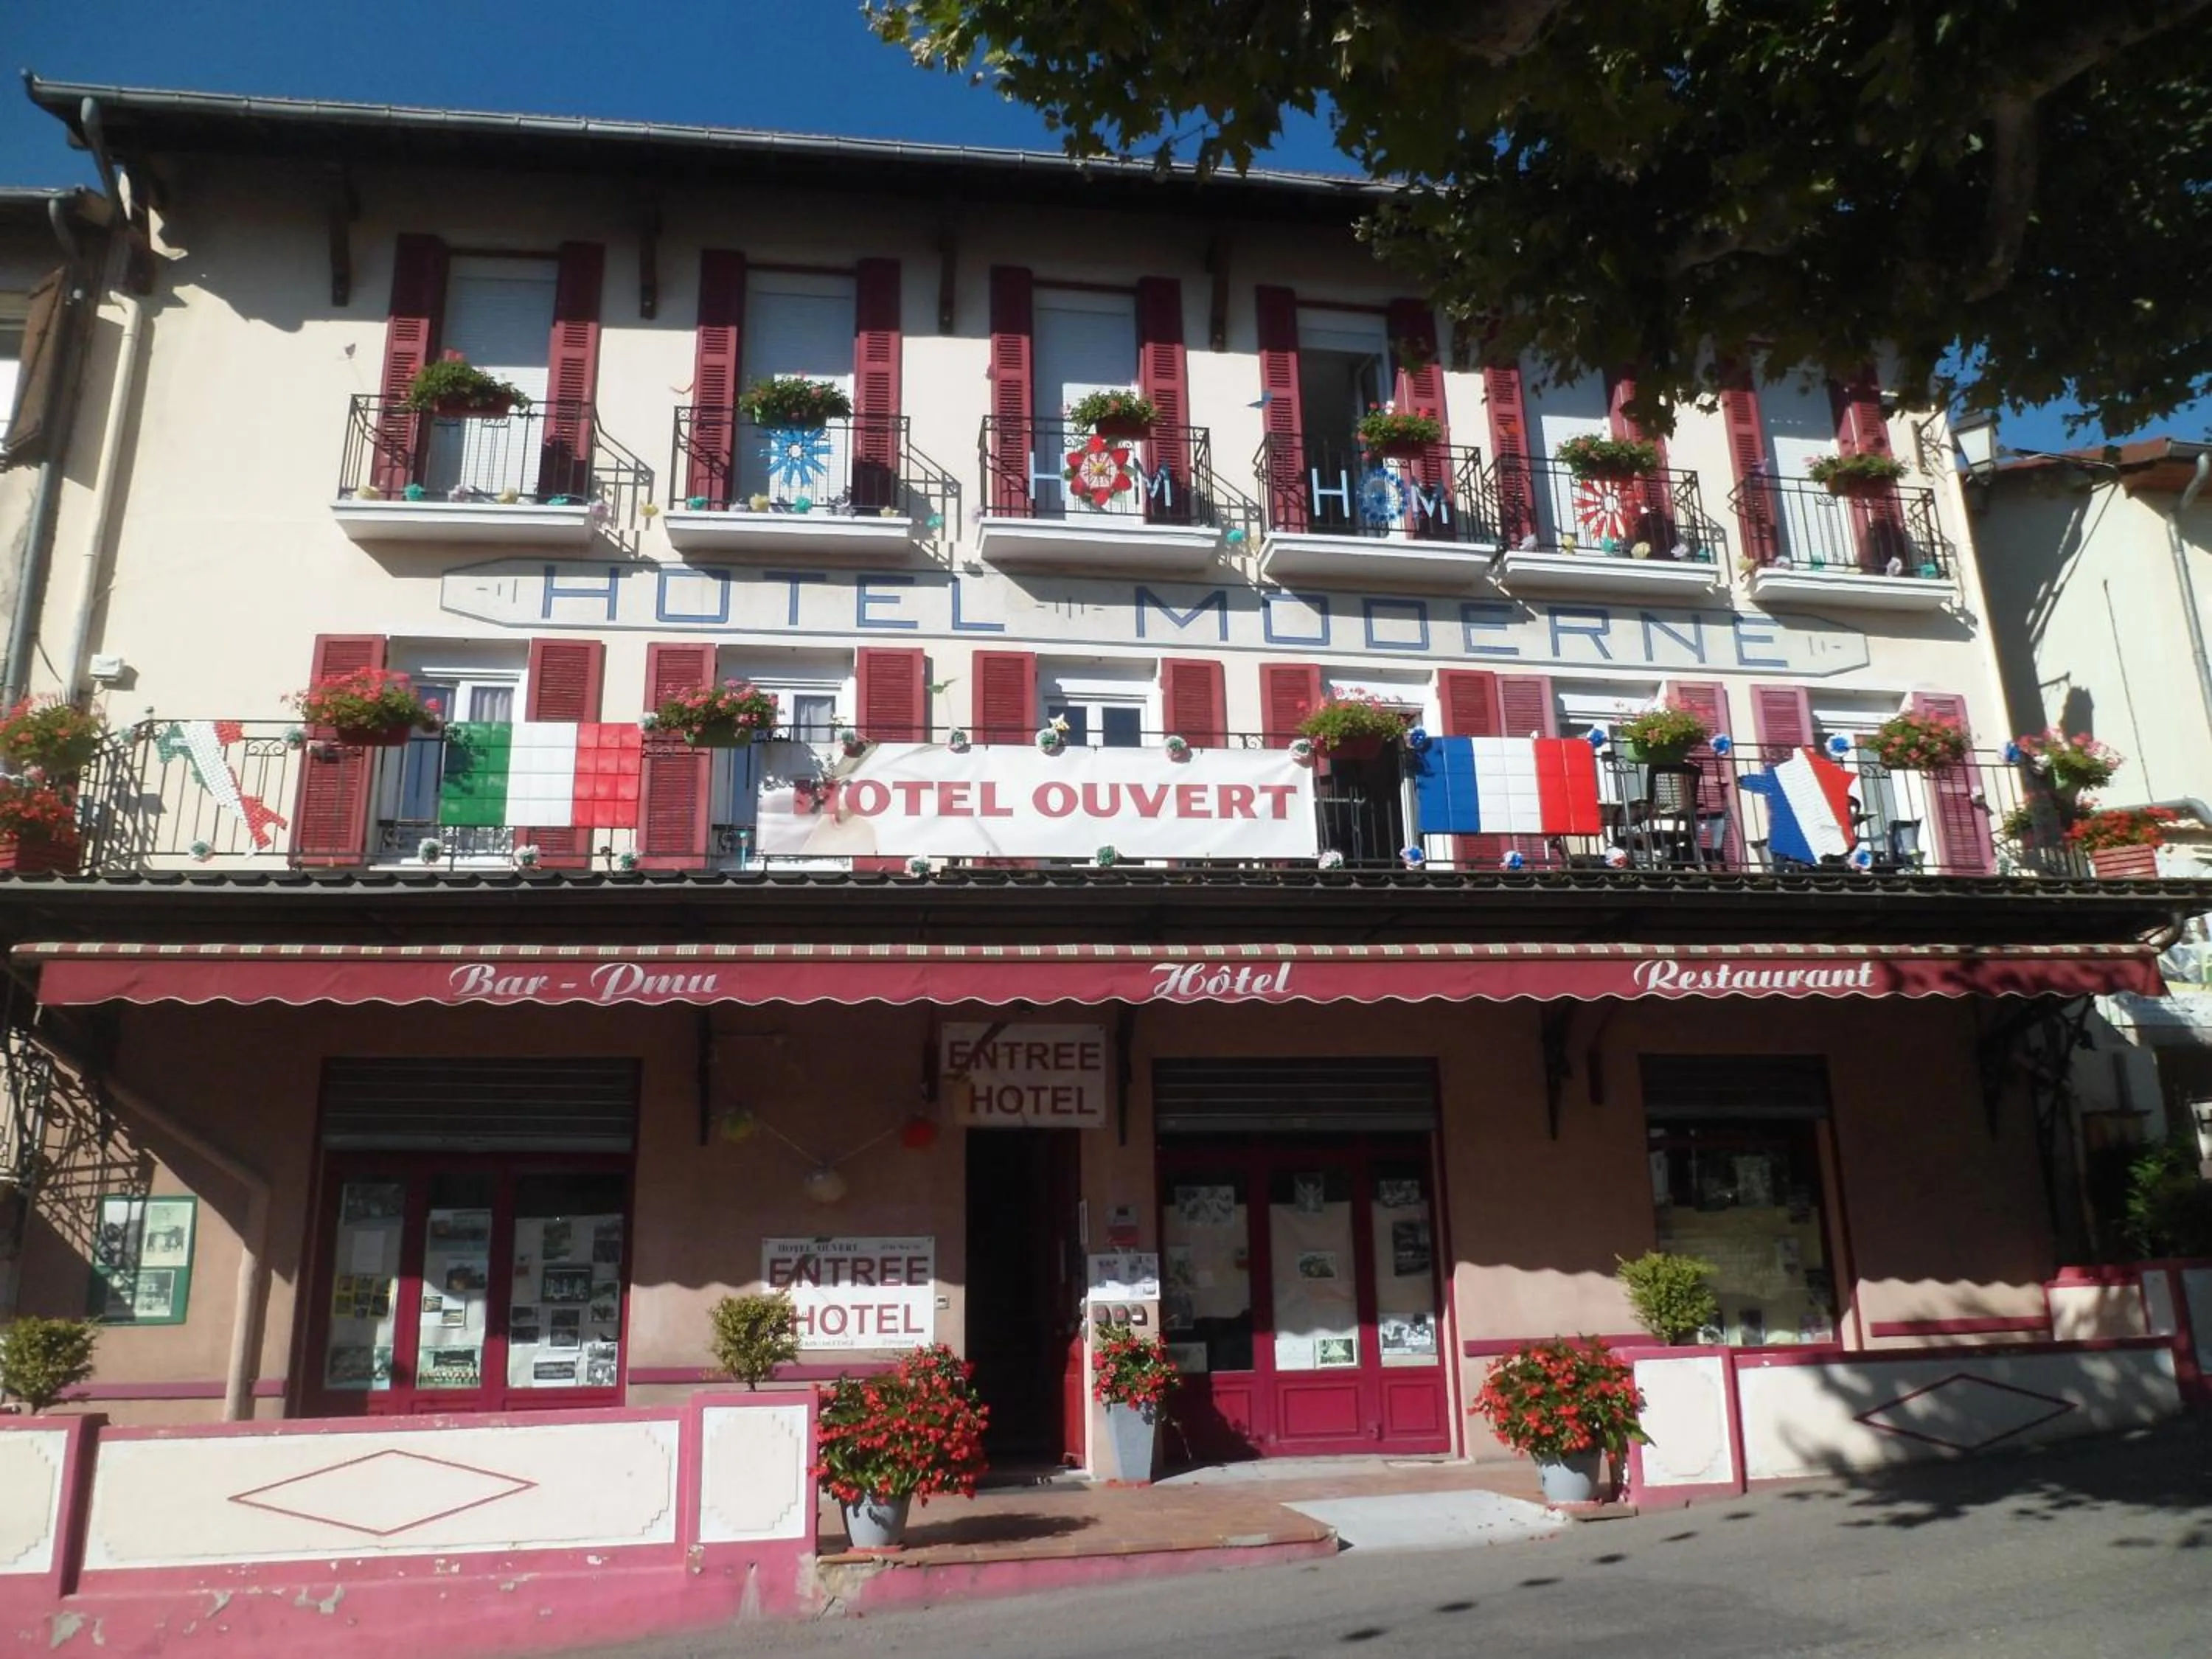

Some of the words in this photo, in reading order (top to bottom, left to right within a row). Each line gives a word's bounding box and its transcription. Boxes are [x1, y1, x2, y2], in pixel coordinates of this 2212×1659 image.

[541, 565, 1005, 632] HOTEL
[1135, 585, 1788, 668] MODERNE
[1032, 780, 1298, 821] OUVERT
[449, 964, 549, 997] Bar
[1150, 961, 1294, 996] Hôtel
[1633, 959, 1876, 990] Restaurant
[948, 1040, 1102, 1071] ENTREE
[970, 1085, 1097, 1115] HOTEL
[769, 1256, 929, 1287] ENTREE
[789, 1303, 925, 1335] HOTEL
